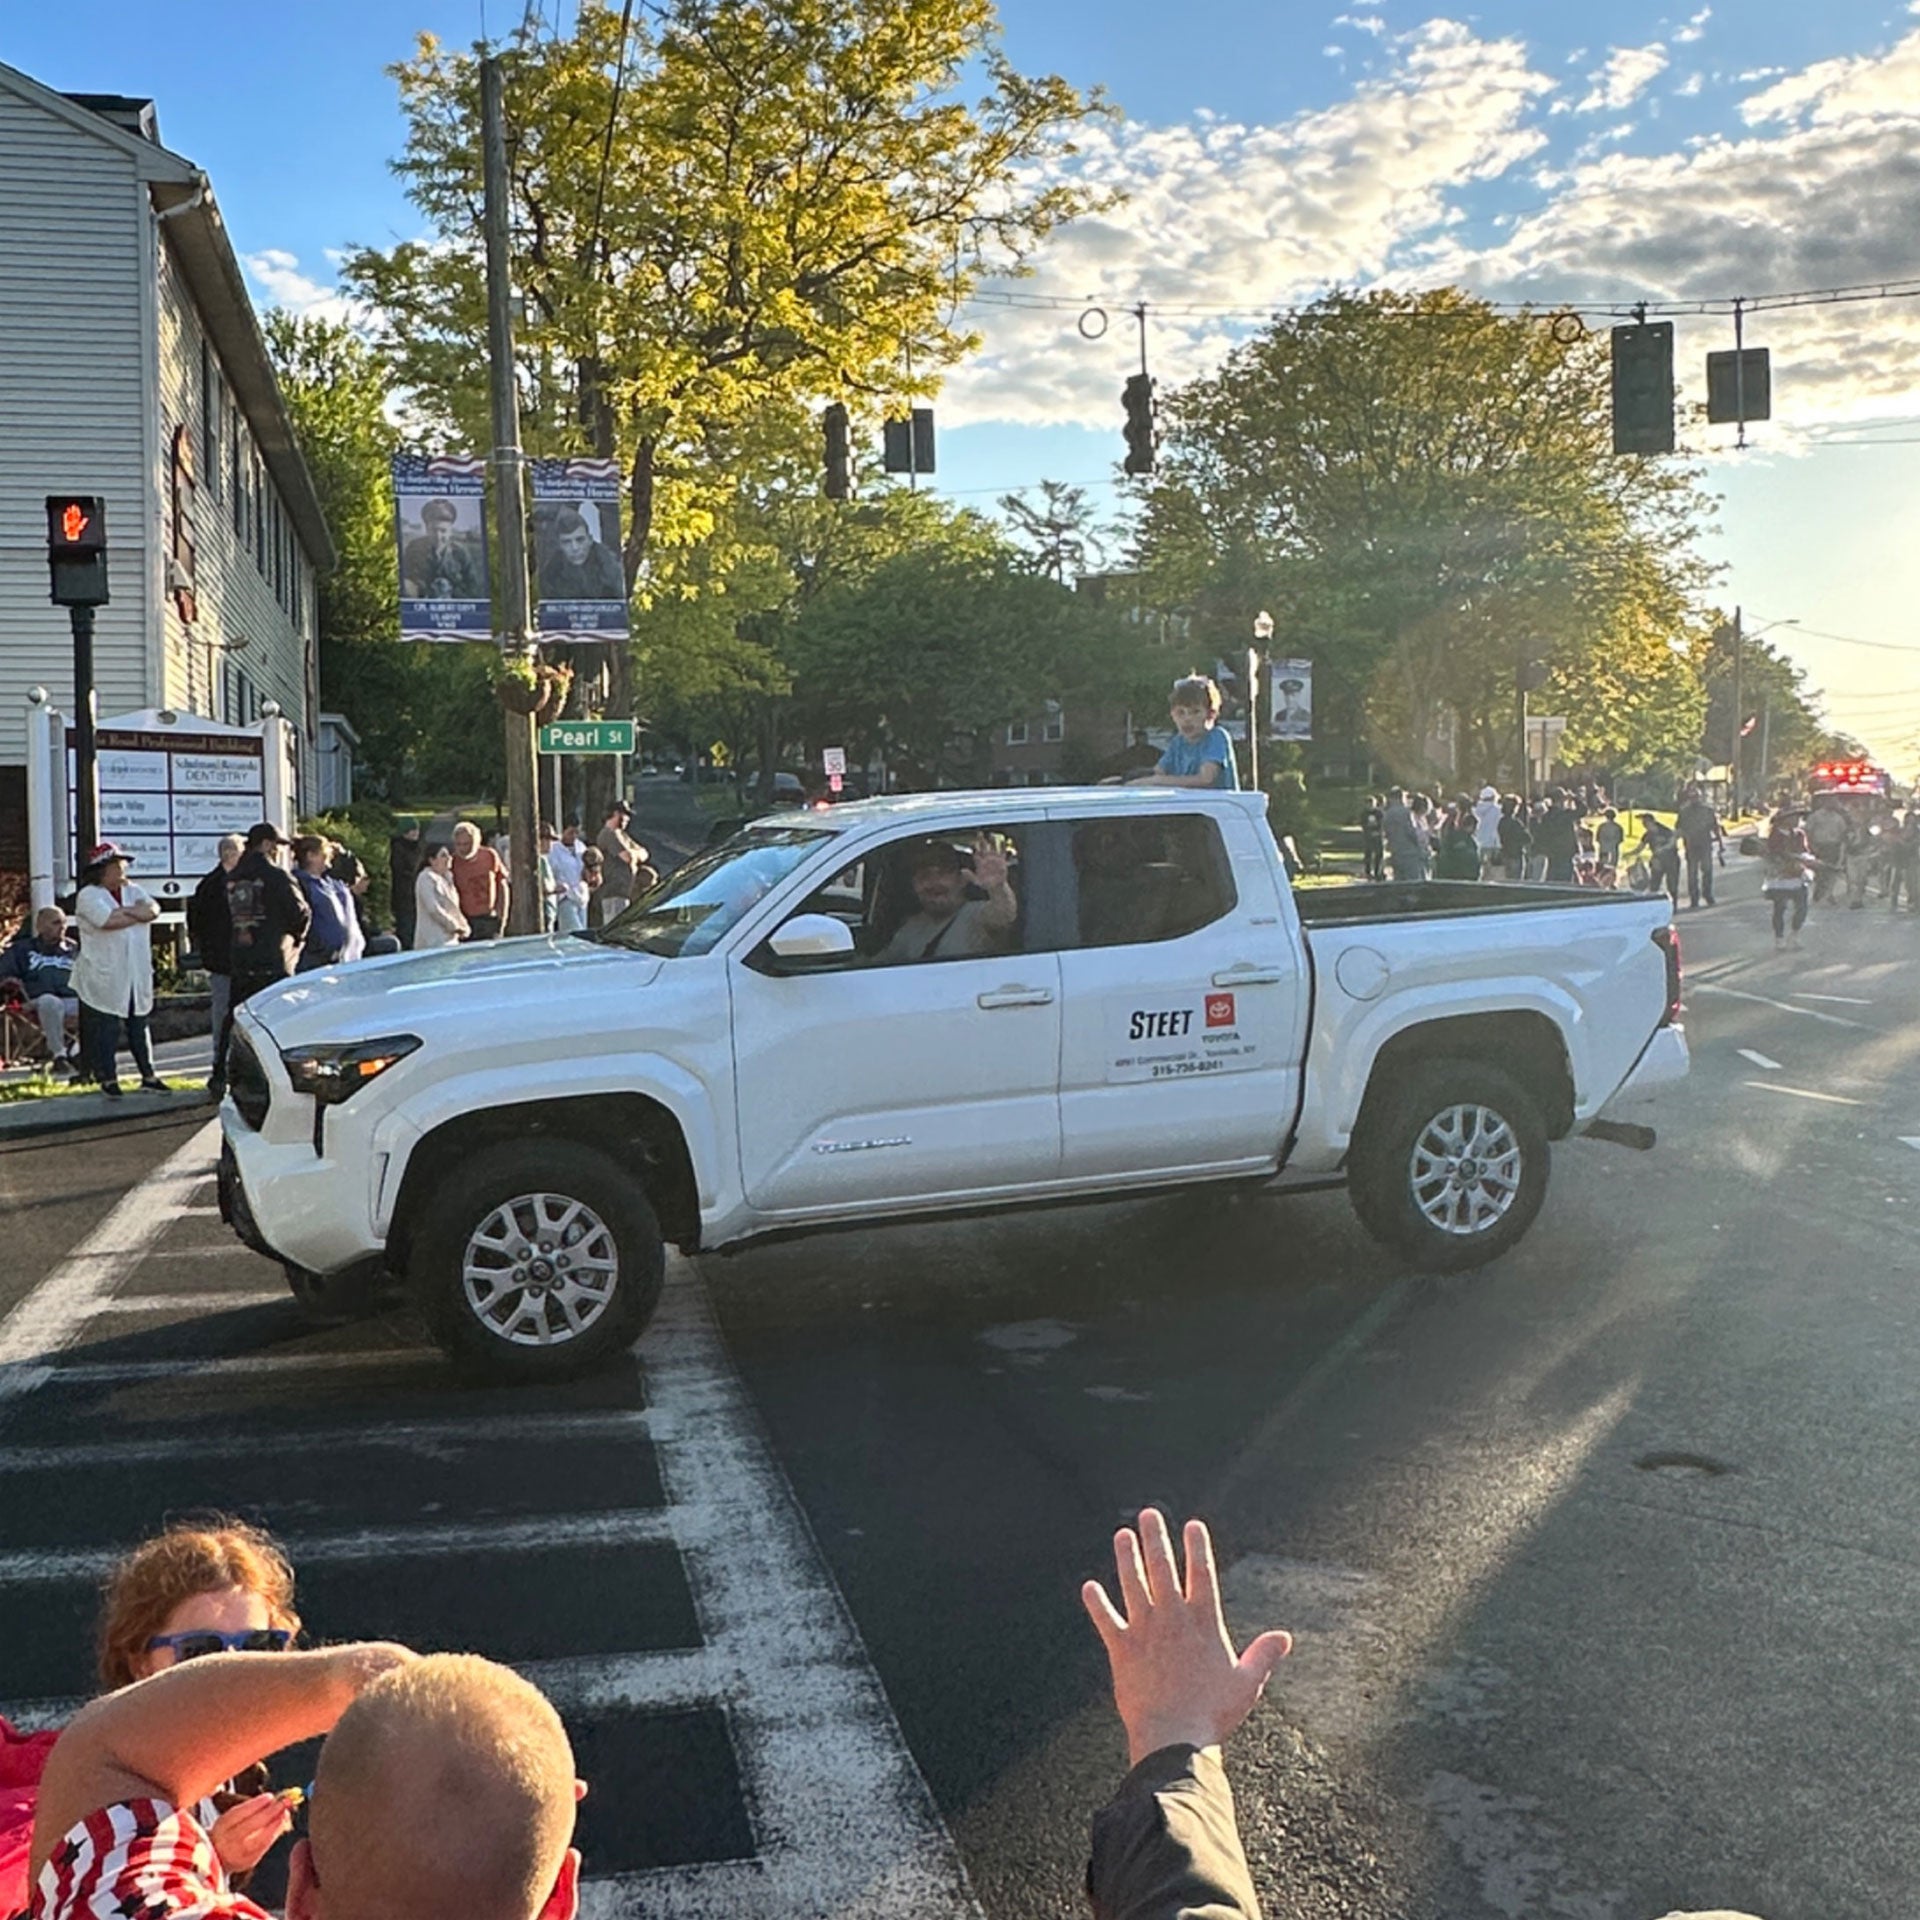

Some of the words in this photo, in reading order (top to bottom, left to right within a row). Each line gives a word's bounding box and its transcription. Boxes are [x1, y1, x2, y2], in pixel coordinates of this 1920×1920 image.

[141, 737, 206, 749] Professional
[550, 728, 599, 746] Pearl
[608, 730, 622, 744] St
[185, 770, 249, 782] DENTISTRY
[1129, 1009, 1194, 1041] STEET
[1201, 1032, 1241, 1043] TOYOTA
